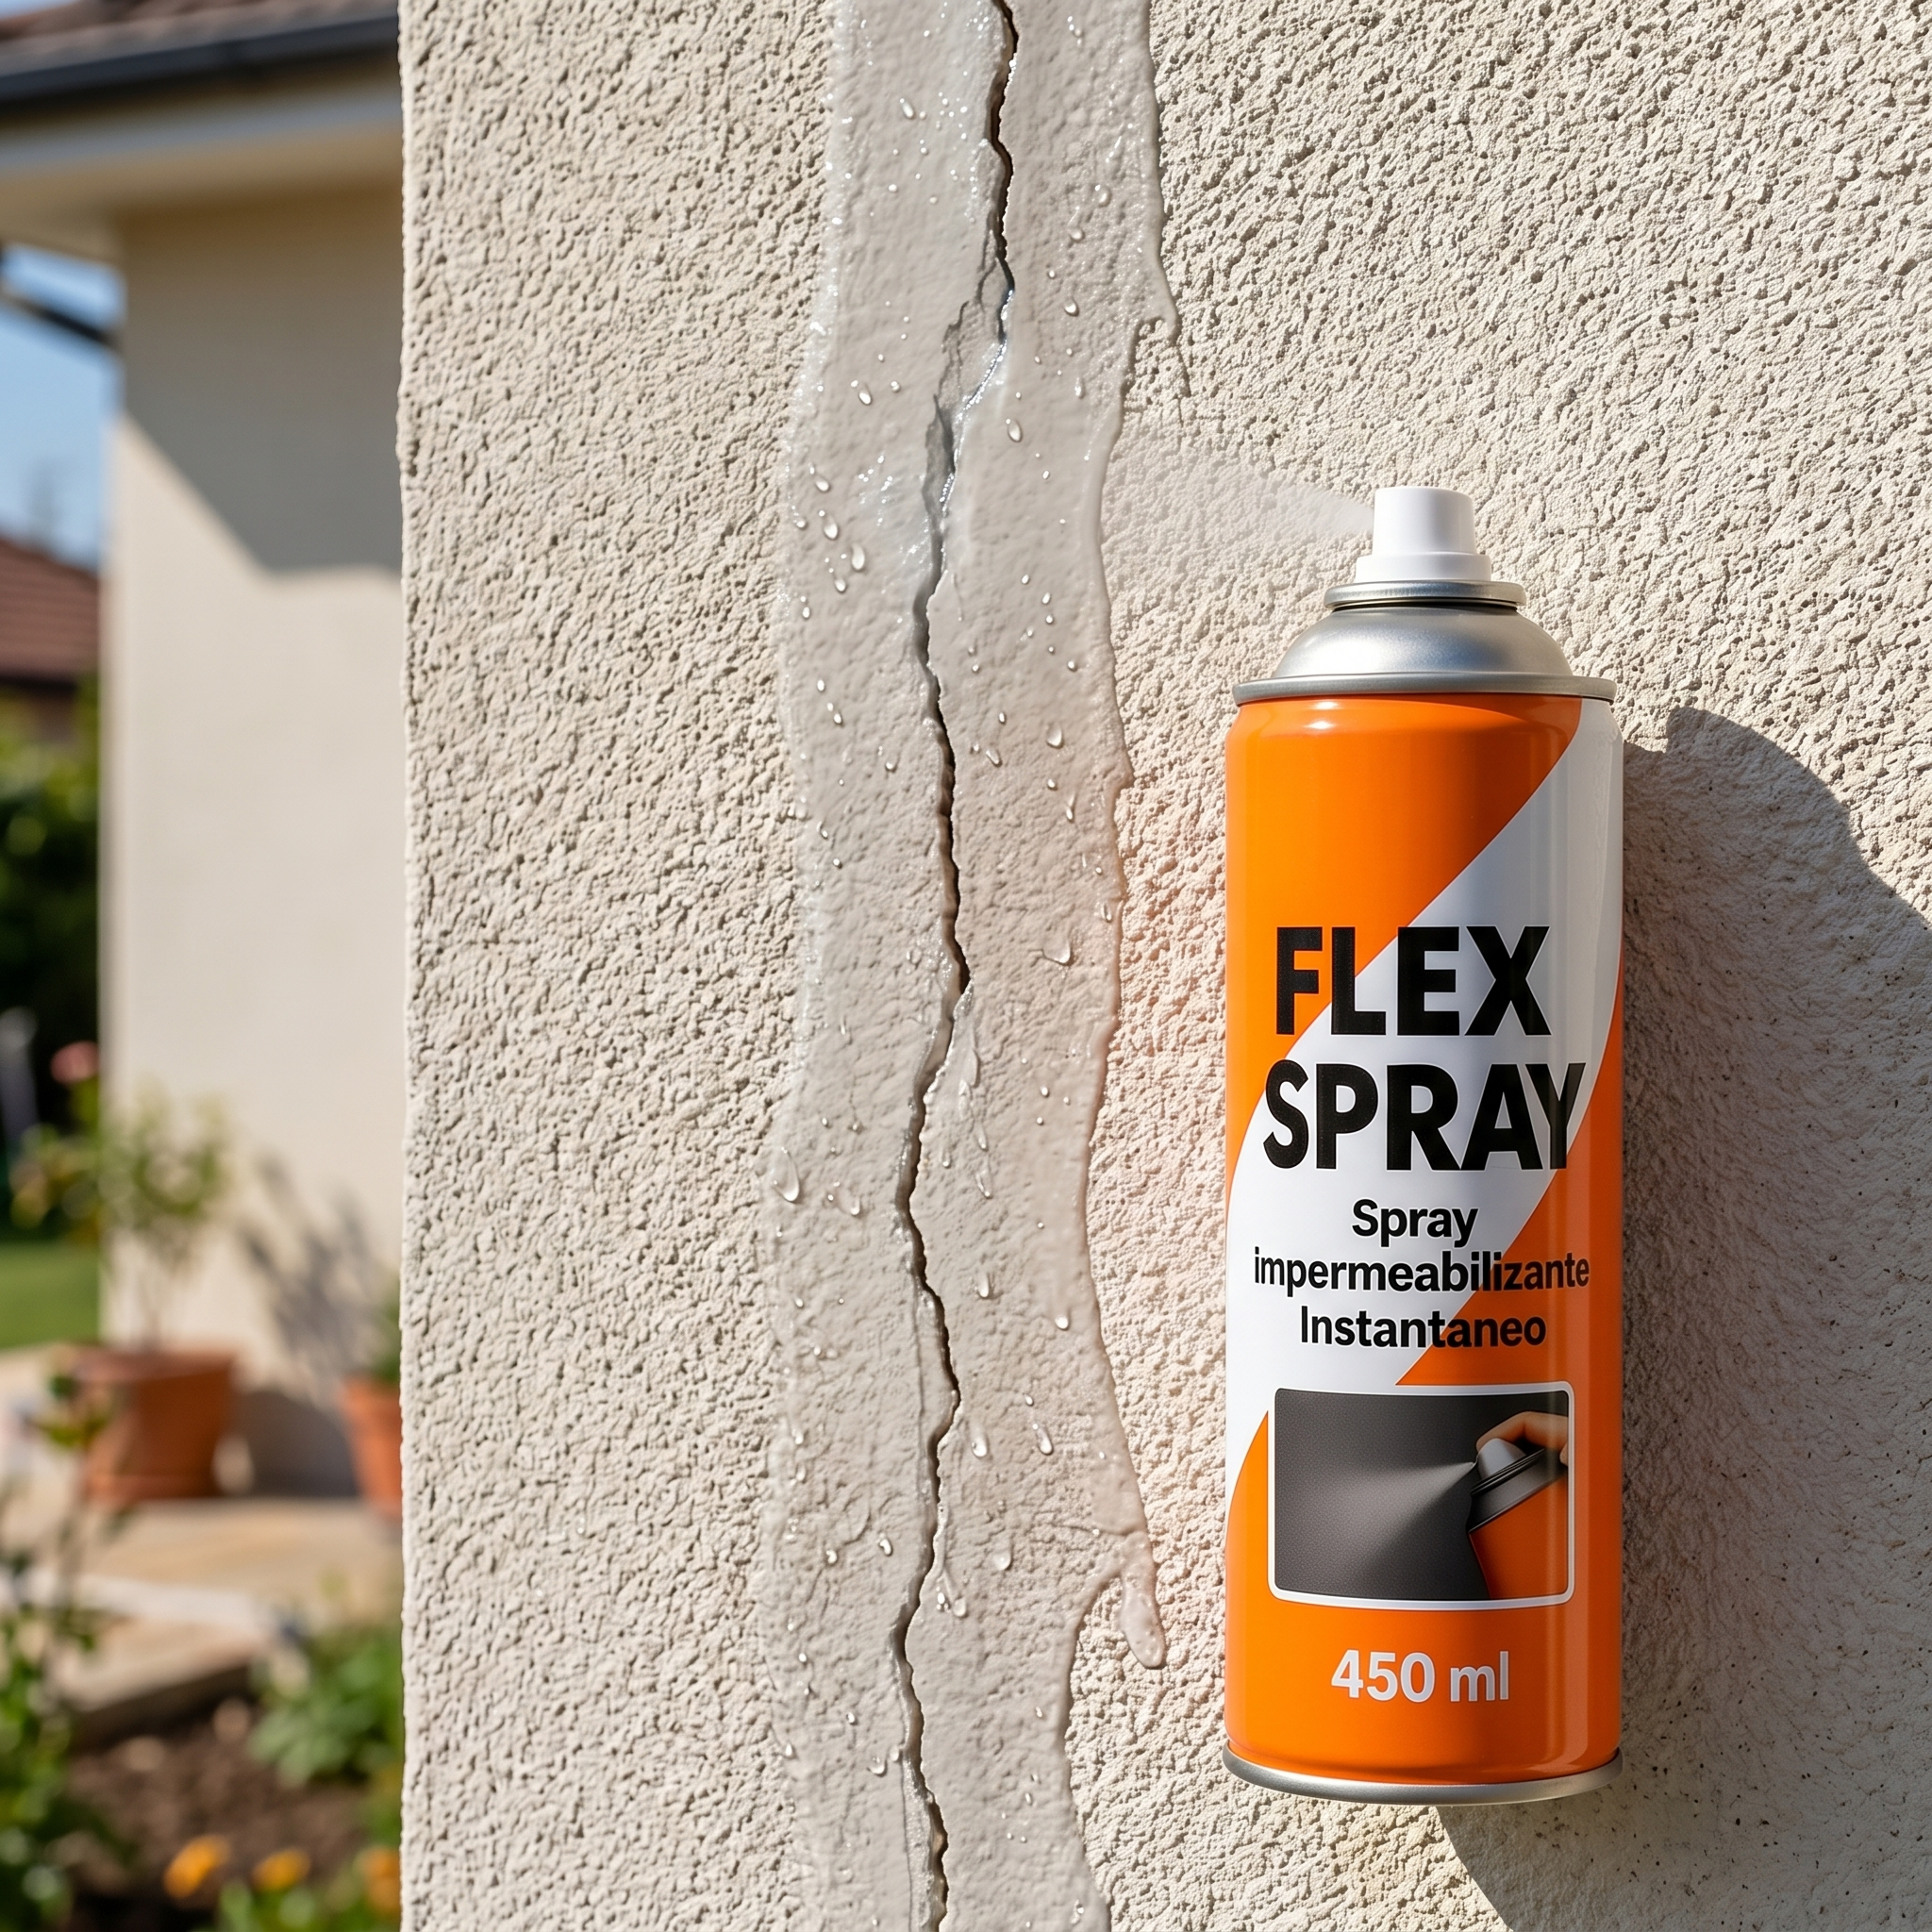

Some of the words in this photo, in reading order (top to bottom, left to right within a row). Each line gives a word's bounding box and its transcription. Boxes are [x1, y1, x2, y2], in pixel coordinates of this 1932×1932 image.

[1275, 925, 1552, 1036] FLEX
[1262, 1058, 1587, 1172] SPRAY
[1352, 1198, 1478, 1248] Spray
[1254, 1245, 1591, 1297] impermeabilizante
[1301, 1305, 1547, 1348] Instantaneo
[1331, 1649, 1435, 1702] 450
[1450, 1651, 1509, 1702] ml
